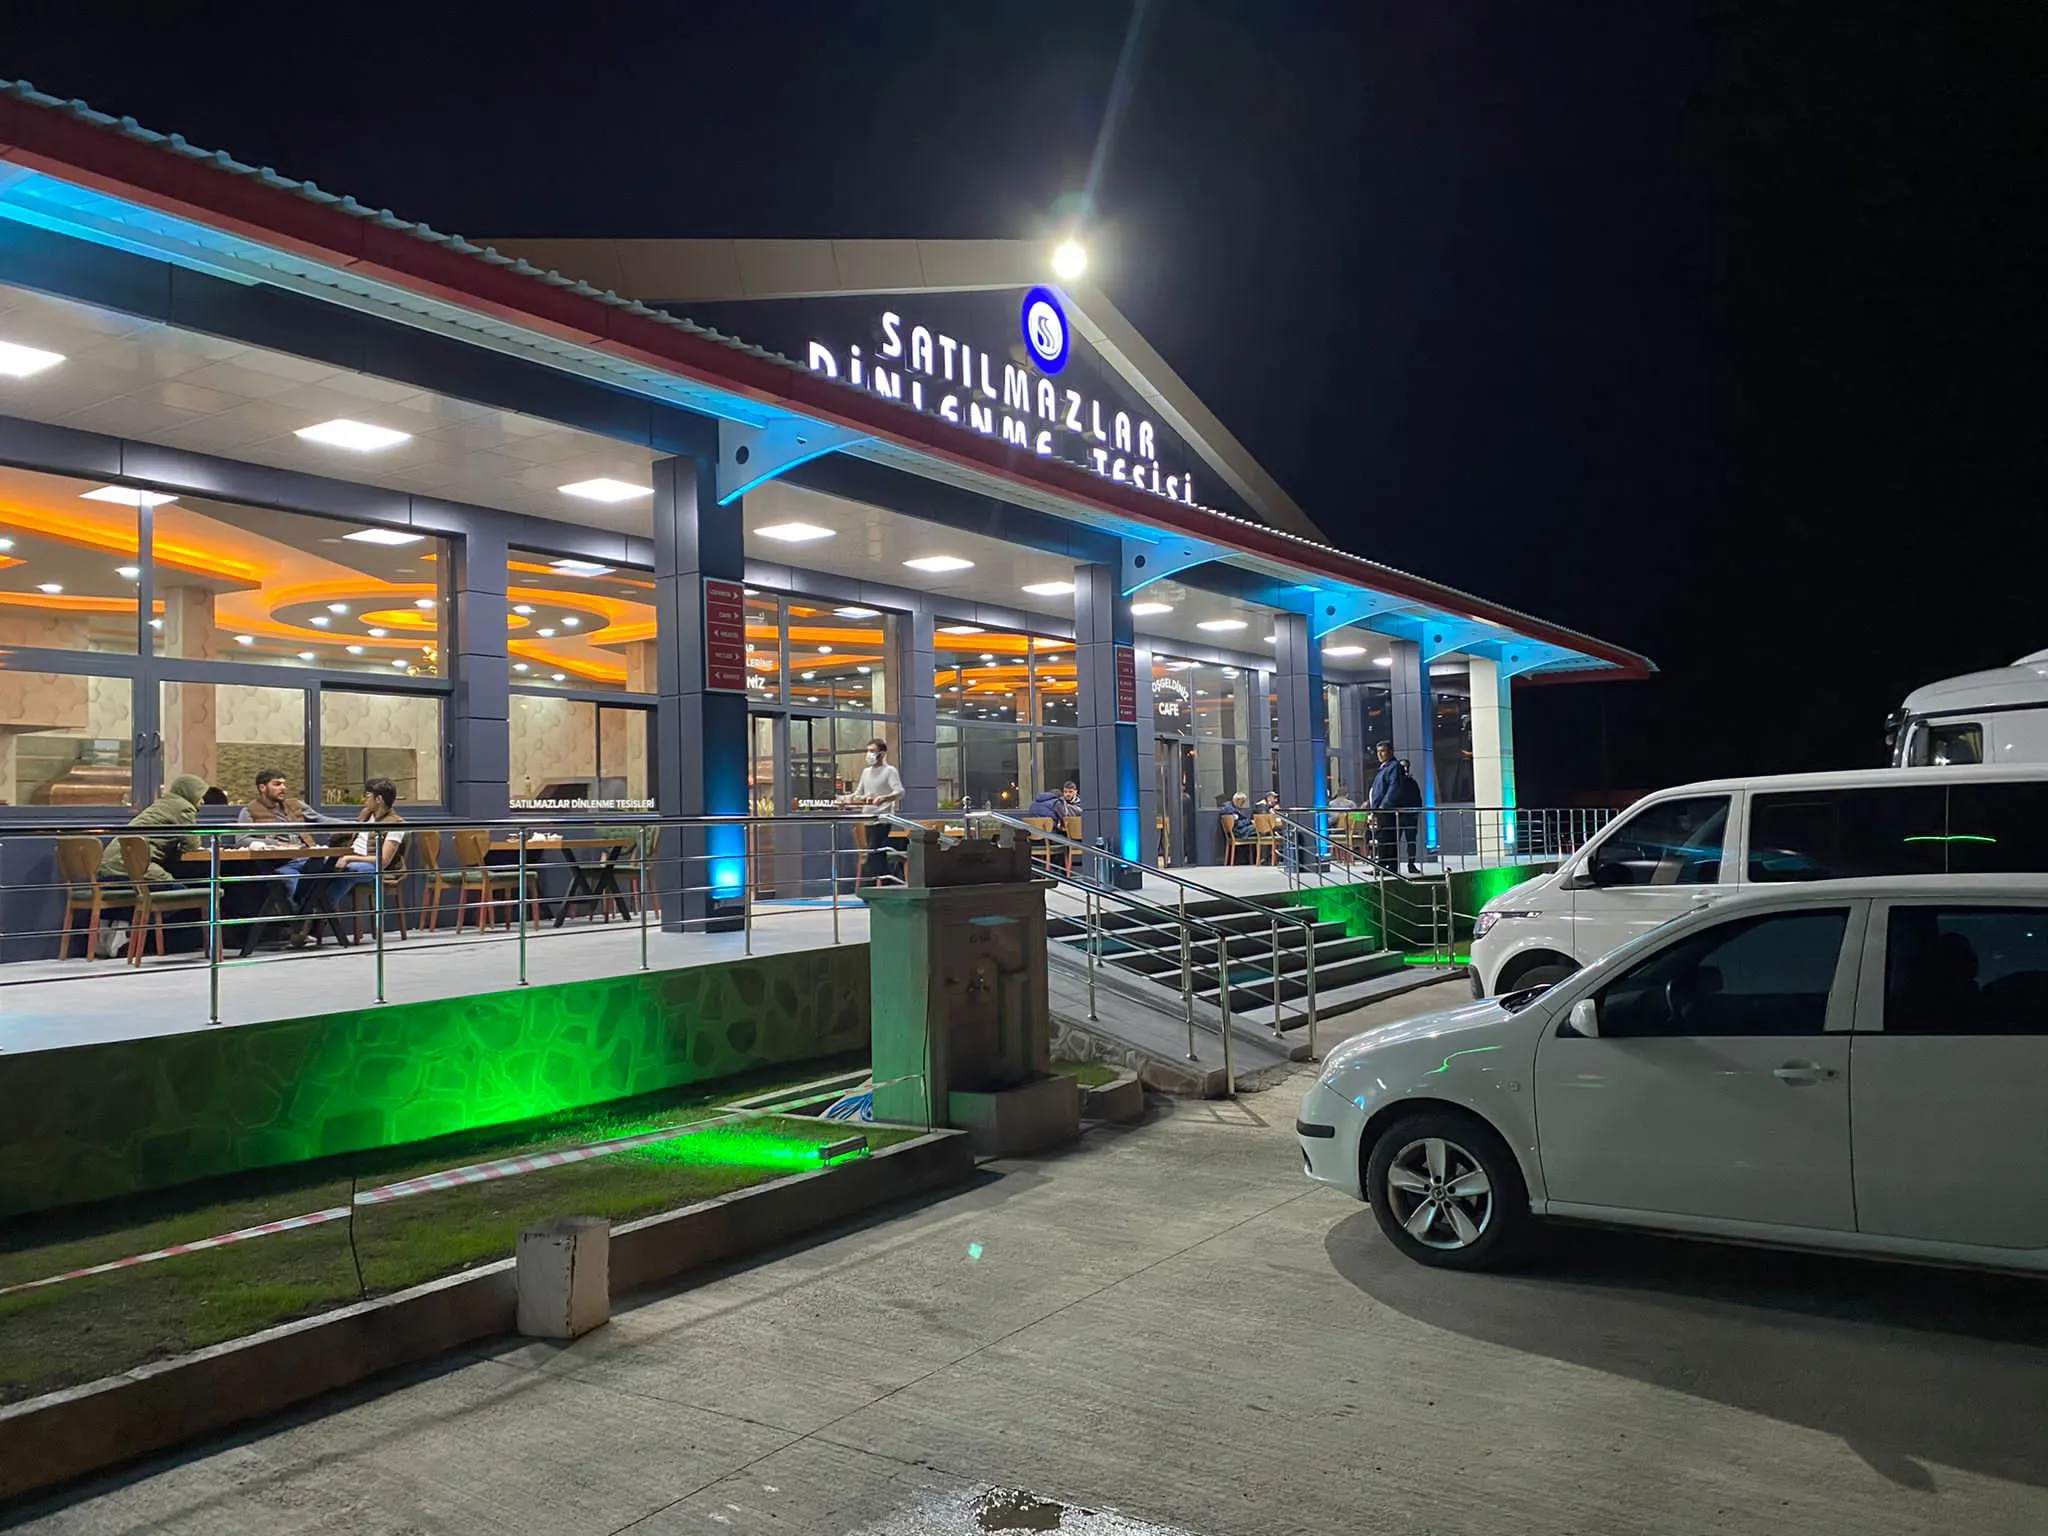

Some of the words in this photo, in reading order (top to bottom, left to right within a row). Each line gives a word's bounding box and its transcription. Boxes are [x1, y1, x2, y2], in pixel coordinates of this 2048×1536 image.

[881, 310, 1156, 460] SATILMAZLAR
[1093, 447, 1193, 506] TESİSİ
[1151, 678, 1190, 702] OŞGELDİNİZ
[1158, 702, 1180, 717] CAFE
[509, 799, 570, 809] SATILMAZLAR
[571, 798, 615, 809] DİNLENME
[616, 799, 655, 809] TESİSLERİ
